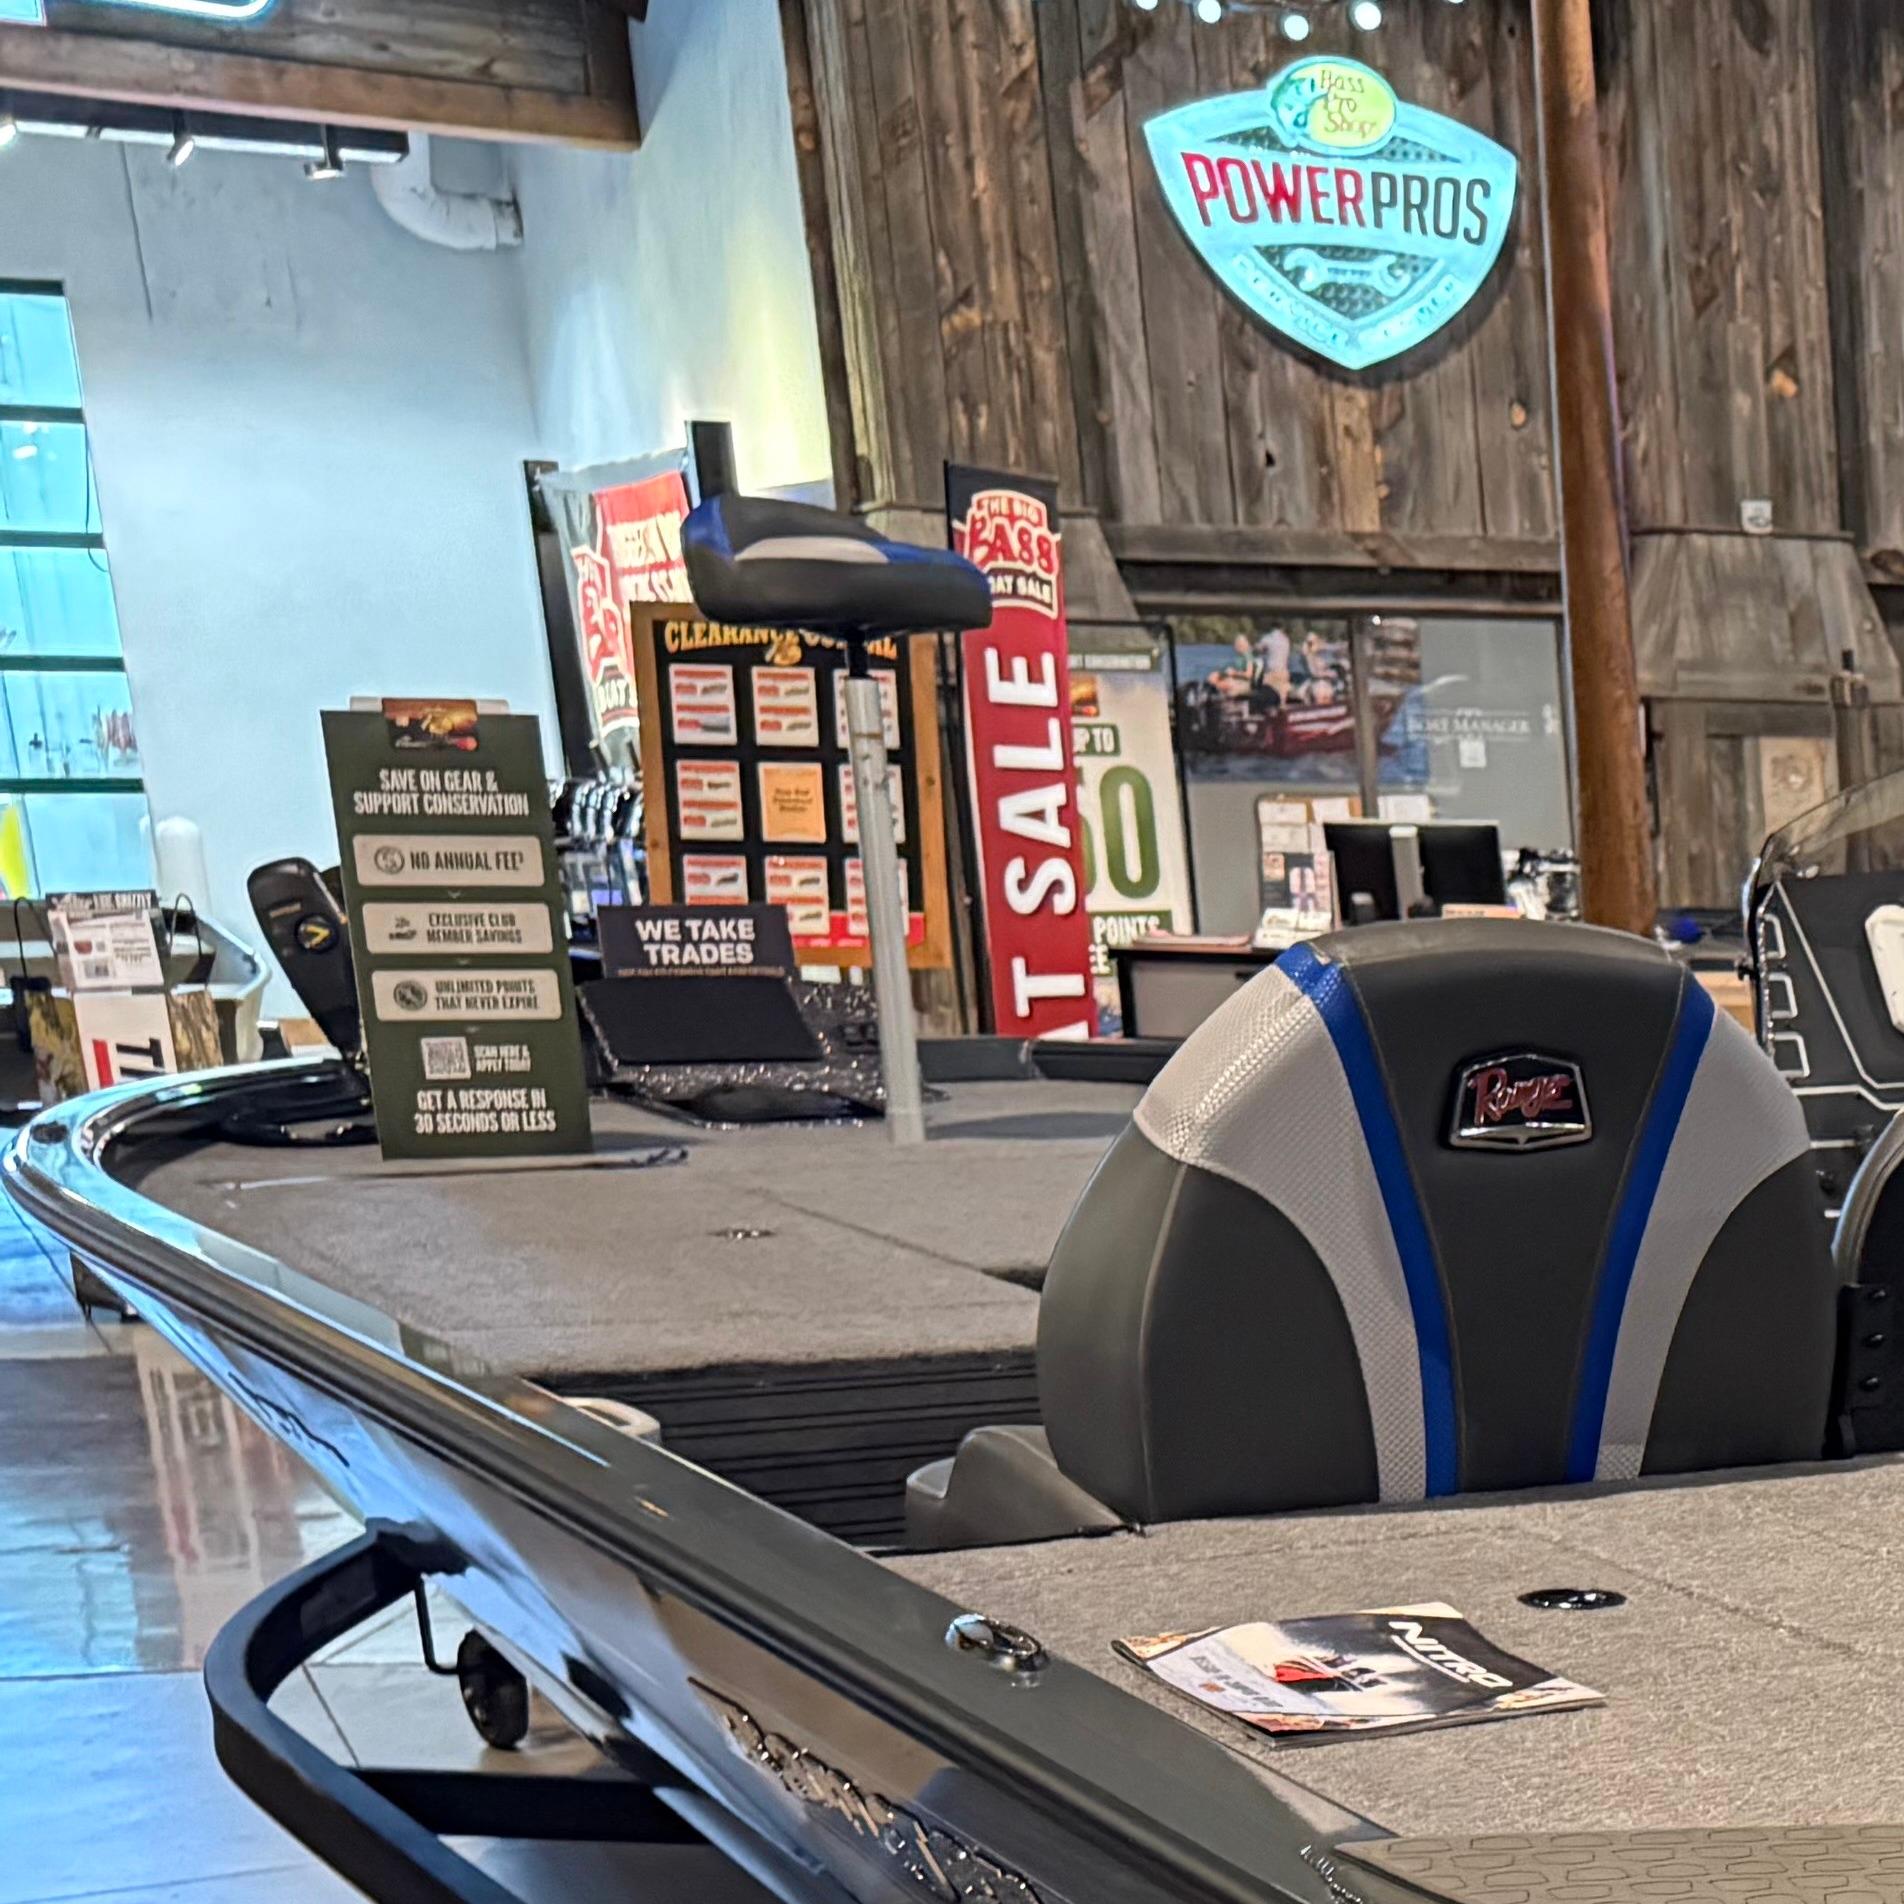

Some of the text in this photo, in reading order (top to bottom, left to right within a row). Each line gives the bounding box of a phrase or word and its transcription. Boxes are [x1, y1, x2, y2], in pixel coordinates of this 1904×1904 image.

[379, 769, 498, 793] SAVE ON GEAR &
[984, 647, 1078, 917] SALE
[353, 792, 529, 817] SUPPORT CONSERVATION
[410, 851, 430, 870] NO
[435, 851, 492, 870] ANNUAL
[428, 913, 516, 928] EXCLUSIVE CLUB
[635, 919, 756, 942] WE TAKE
[427, 929, 522, 944] MEMBER SAVINGS
[643, 943, 754, 967] TRADES
[435, 980, 493, 994] UNLIMITED
[436, 997, 461, 1011] THAT
[465, 997, 499, 1011] NEVER
[416, 1088, 547, 1111] GET A RESPONSE IN
[414, 1110, 557, 1135] 30 SECONDS OR LESS
[1388, 1621, 1514, 1689] NITRO
